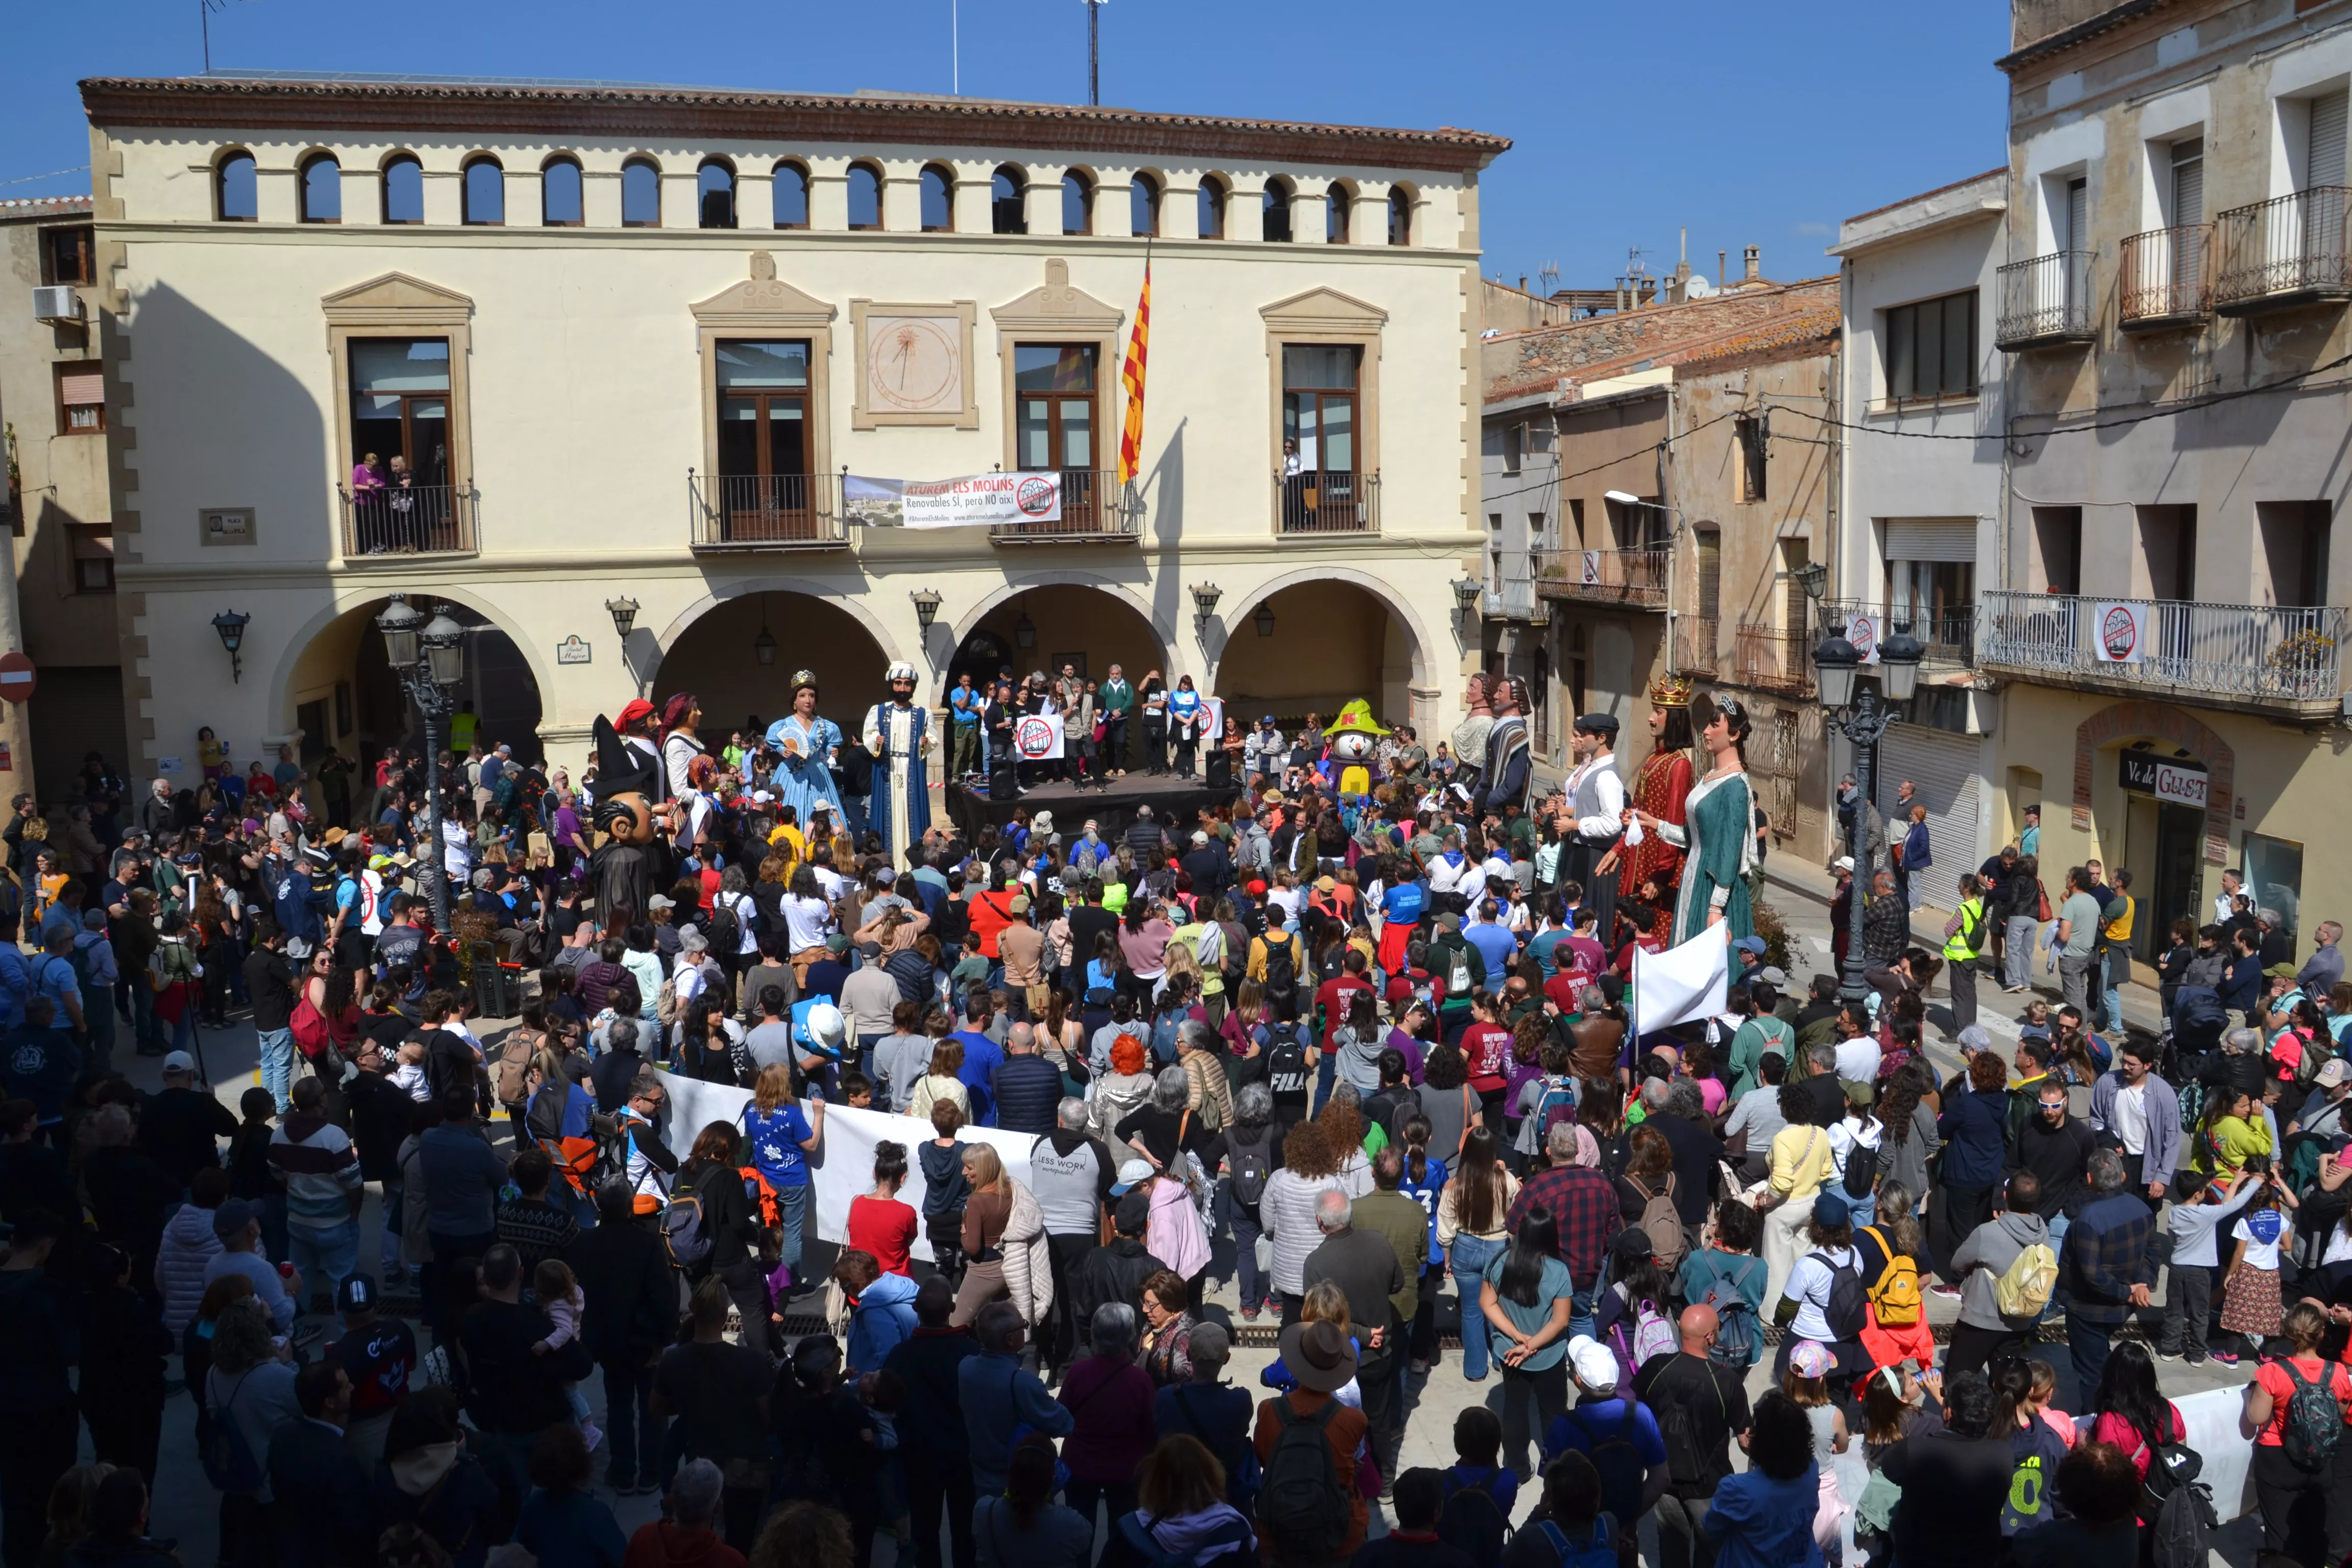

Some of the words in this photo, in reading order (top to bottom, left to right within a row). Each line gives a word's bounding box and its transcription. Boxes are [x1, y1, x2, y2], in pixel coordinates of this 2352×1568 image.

[906, 483, 950, 495] ATUREM
[952, 481, 969, 494] ELS
[973, 478, 1014, 493] MOLINS
[906, 496, 950, 508] Renovables
[965, 495, 983, 508] però
[985, 494, 996, 505] NO
[999, 494, 1013, 504] així
[2128, 761, 2141, 782] Ve
[2142, 765, 2154, 785] de
[1270, 1071, 1304, 1091] FILA
[1057, 1159, 1085, 1170] WORK
